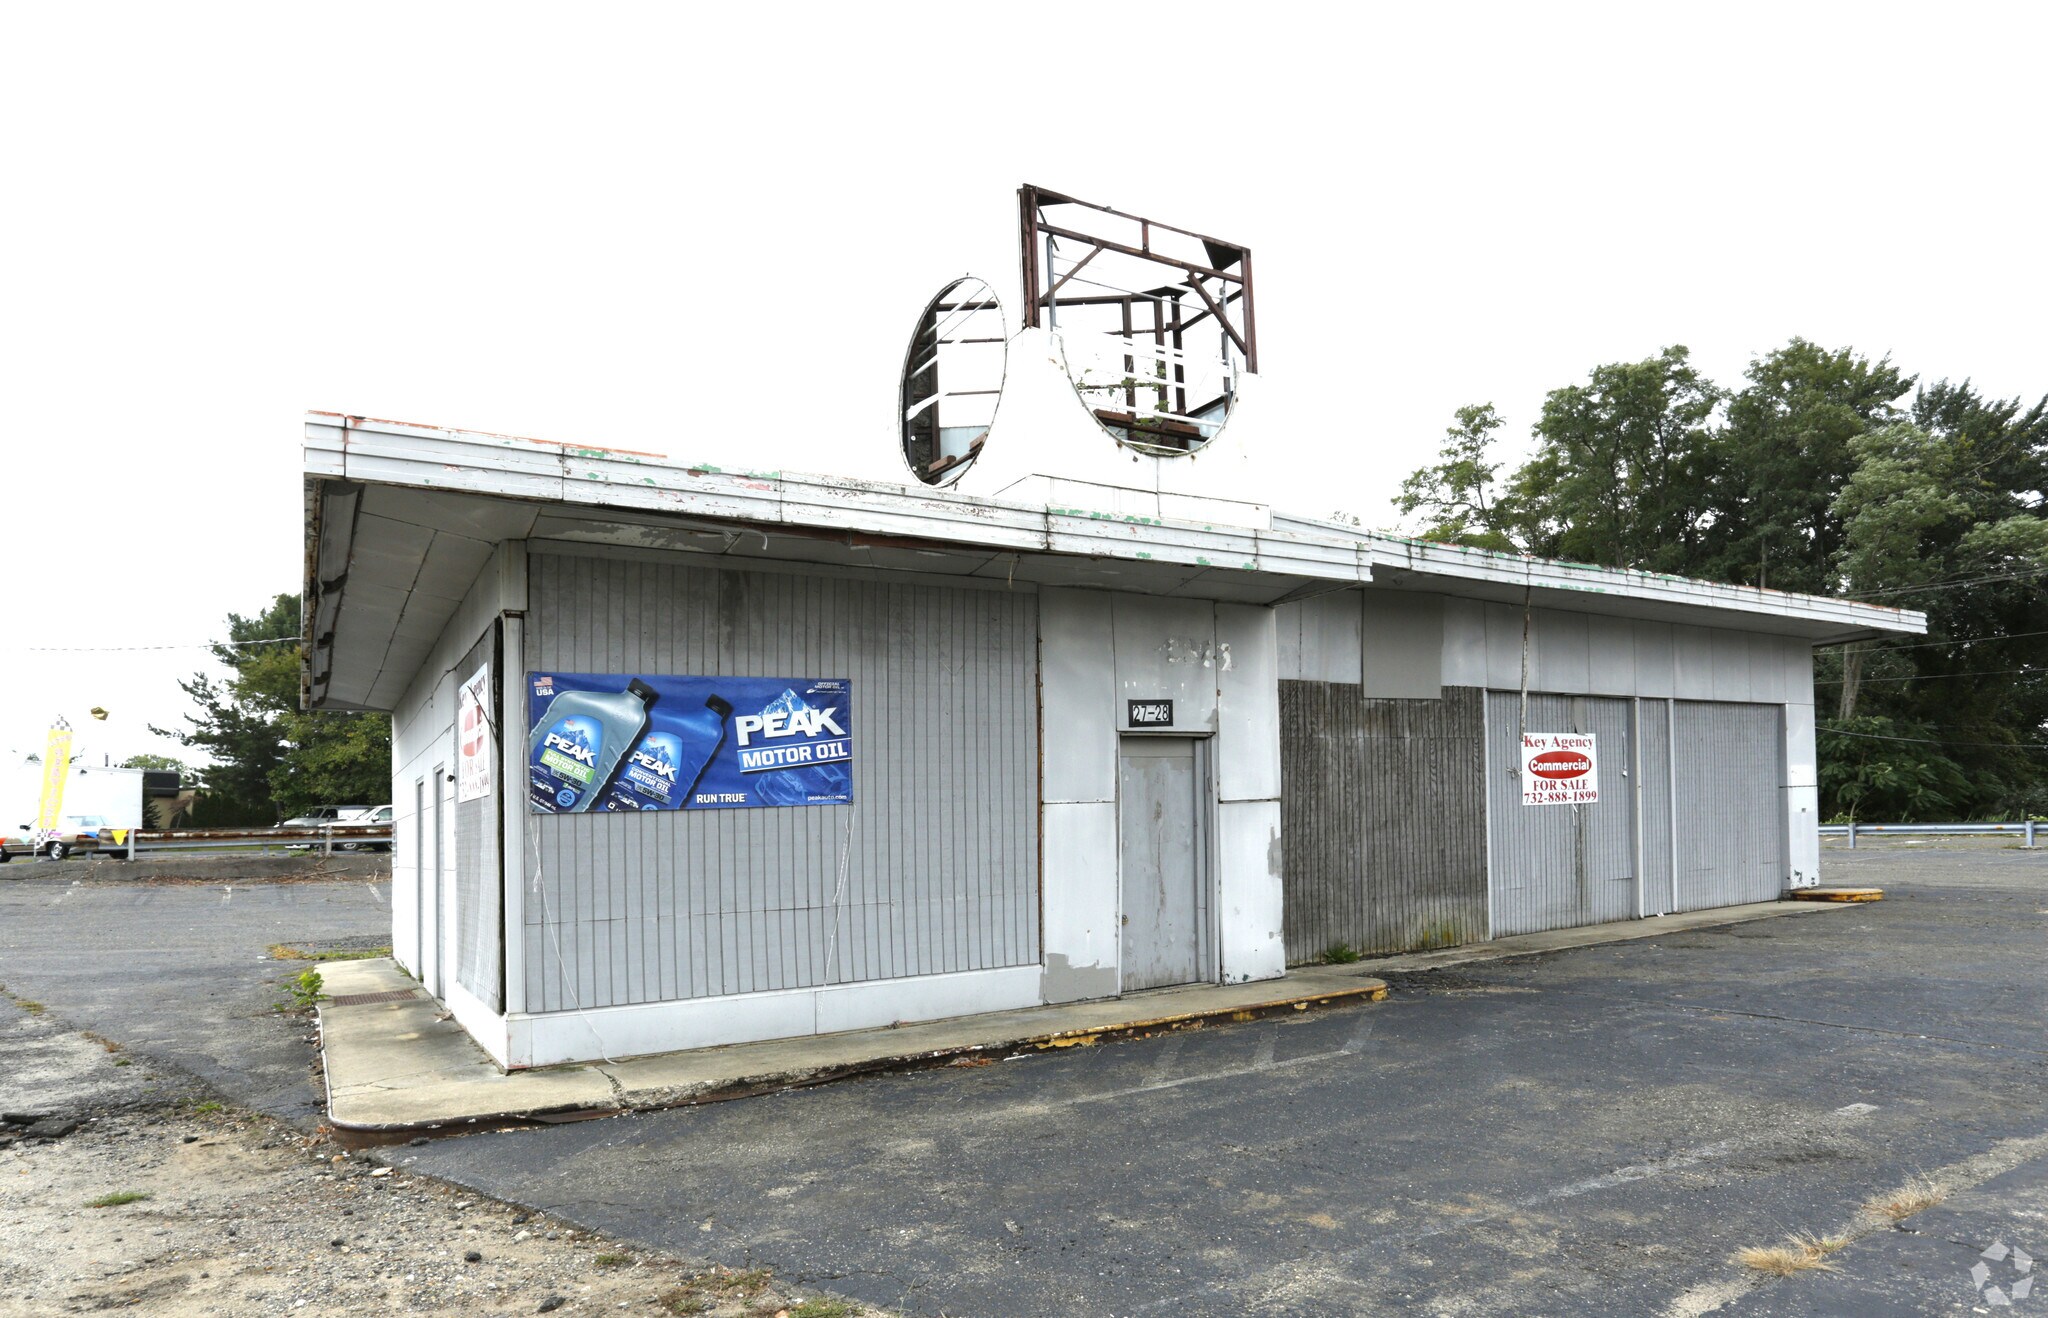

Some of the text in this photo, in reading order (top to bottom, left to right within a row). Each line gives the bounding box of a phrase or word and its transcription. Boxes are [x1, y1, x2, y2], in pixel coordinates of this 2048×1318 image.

[536, 688, 554, 696] USA
[1132, 704, 1170, 722] 27-28
[735, 706, 847, 747] PEAK
[543, 732, 596, 768] PEAK
[1524, 735, 1594, 750] Key Agency
[742, 742, 848, 768] MOTOR OIL
[544, 754, 574, 772] MOTOR
[573, 767, 588, 779] OIL
[628, 750, 678, 782] PEAK
[1530, 758, 1589, 772] Commercial
[558, 771, 582, 787] 5W-30
[628, 770, 657, 787] MOTOR
[656, 782, 669, 793] OIL
[631, 766, 672, 788] CONVENTIONAL
[1533, 779, 1589, 791] FOR SALE
[642, 787, 665, 801] 5W-30
[696, 793, 746, 804] RUN TRUE
[807, 794, 848, 802] peakauto.com
[1524, 790, 1597, 804] 732-888-1899
